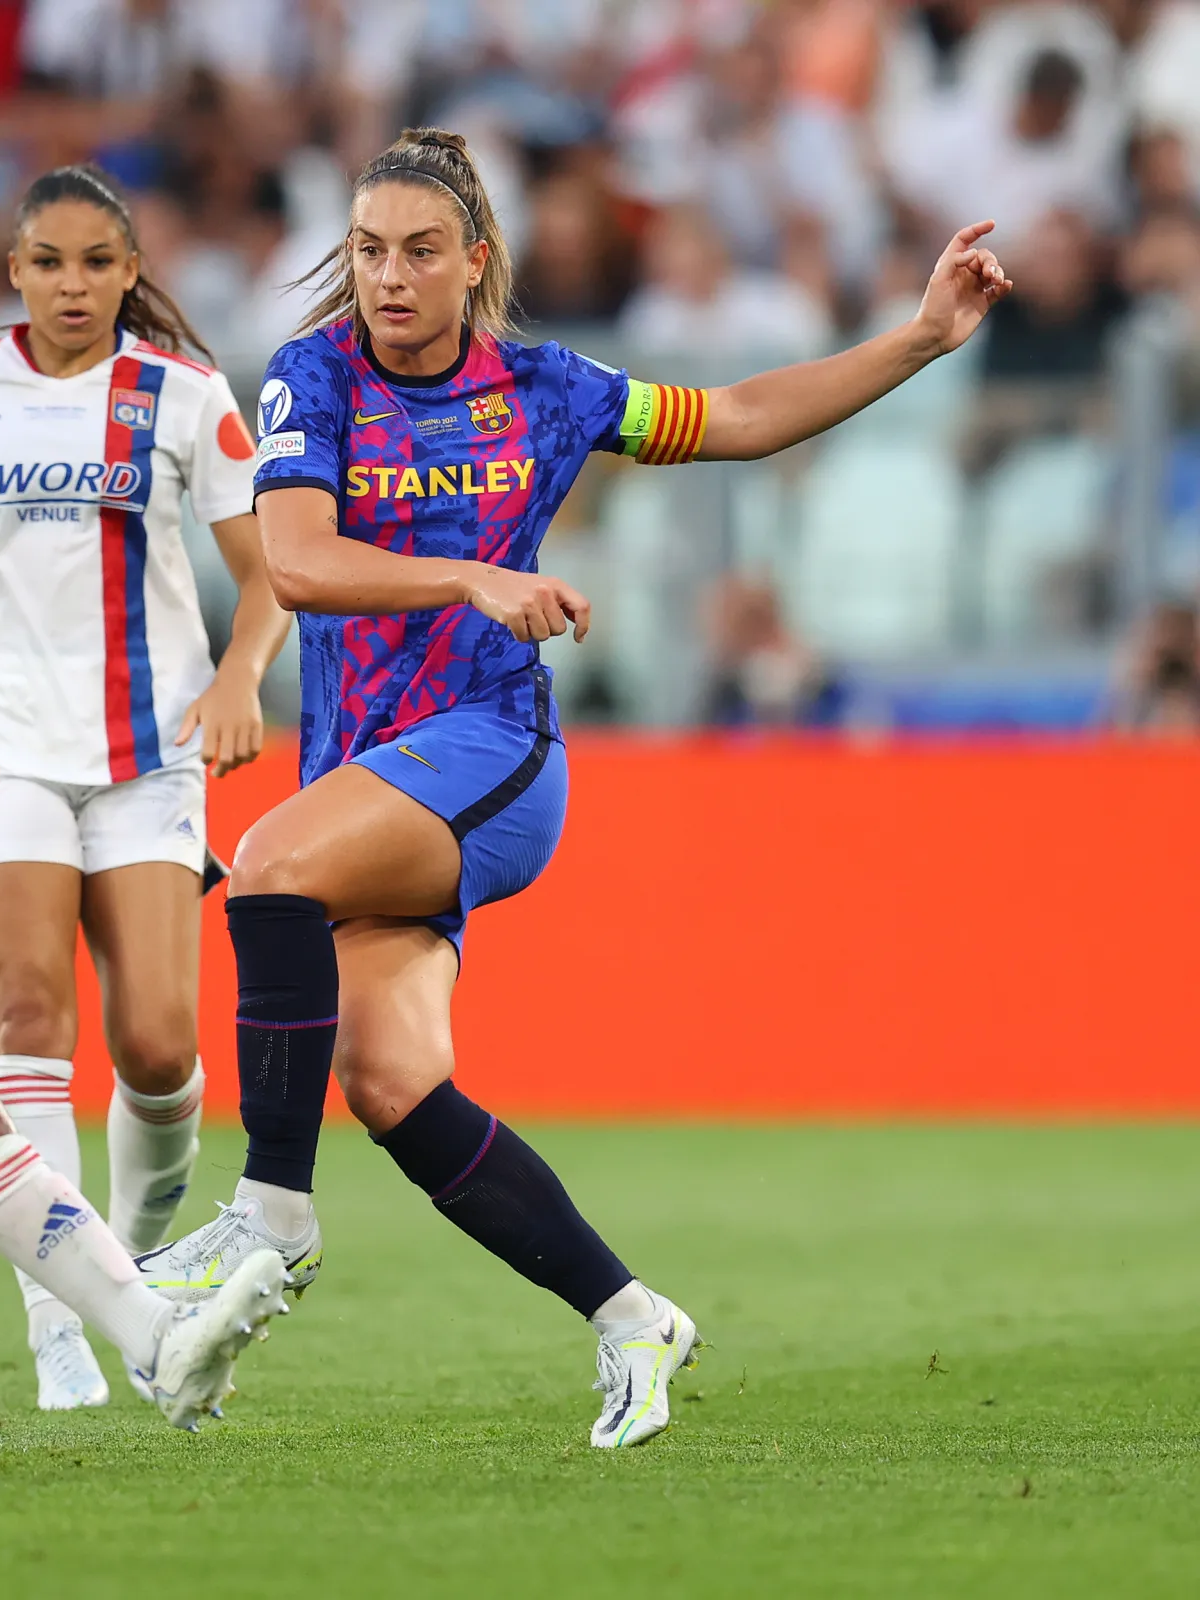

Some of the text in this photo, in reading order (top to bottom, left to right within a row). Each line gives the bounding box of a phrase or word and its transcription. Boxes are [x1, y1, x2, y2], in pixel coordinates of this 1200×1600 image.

[415, 418, 441, 428] TORINO
[441, 415, 459, 425] 2022
[632, 418, 647, 434] NO
[640, 401, 651, 416] TO
[346, 458, 535, 499] STANLEY
[17, 506, 80, 522] VENUE
